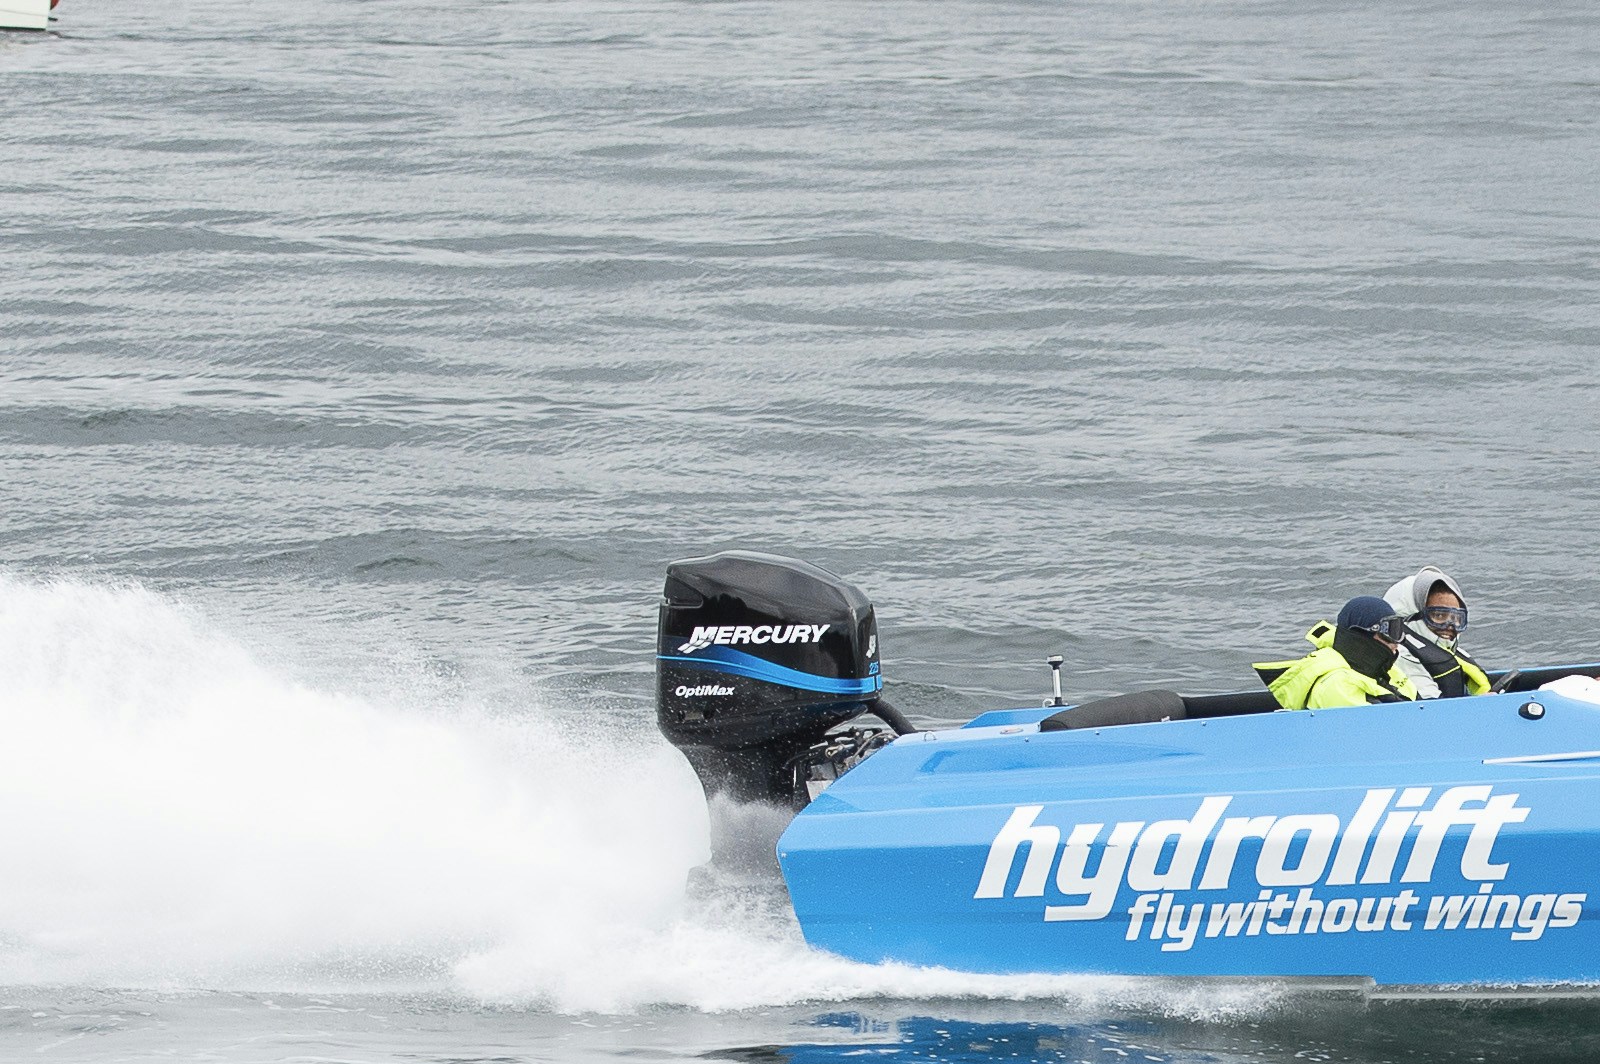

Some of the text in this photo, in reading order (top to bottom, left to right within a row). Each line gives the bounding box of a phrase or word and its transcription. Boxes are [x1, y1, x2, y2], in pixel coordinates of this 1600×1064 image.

[678, 624, 830, 653] MERCURY
[675, 684, 735, 698] OptiMax
[973, 785, 1532, 922] hydrolift
[1125, 882, 1587, 952] fly without wings
